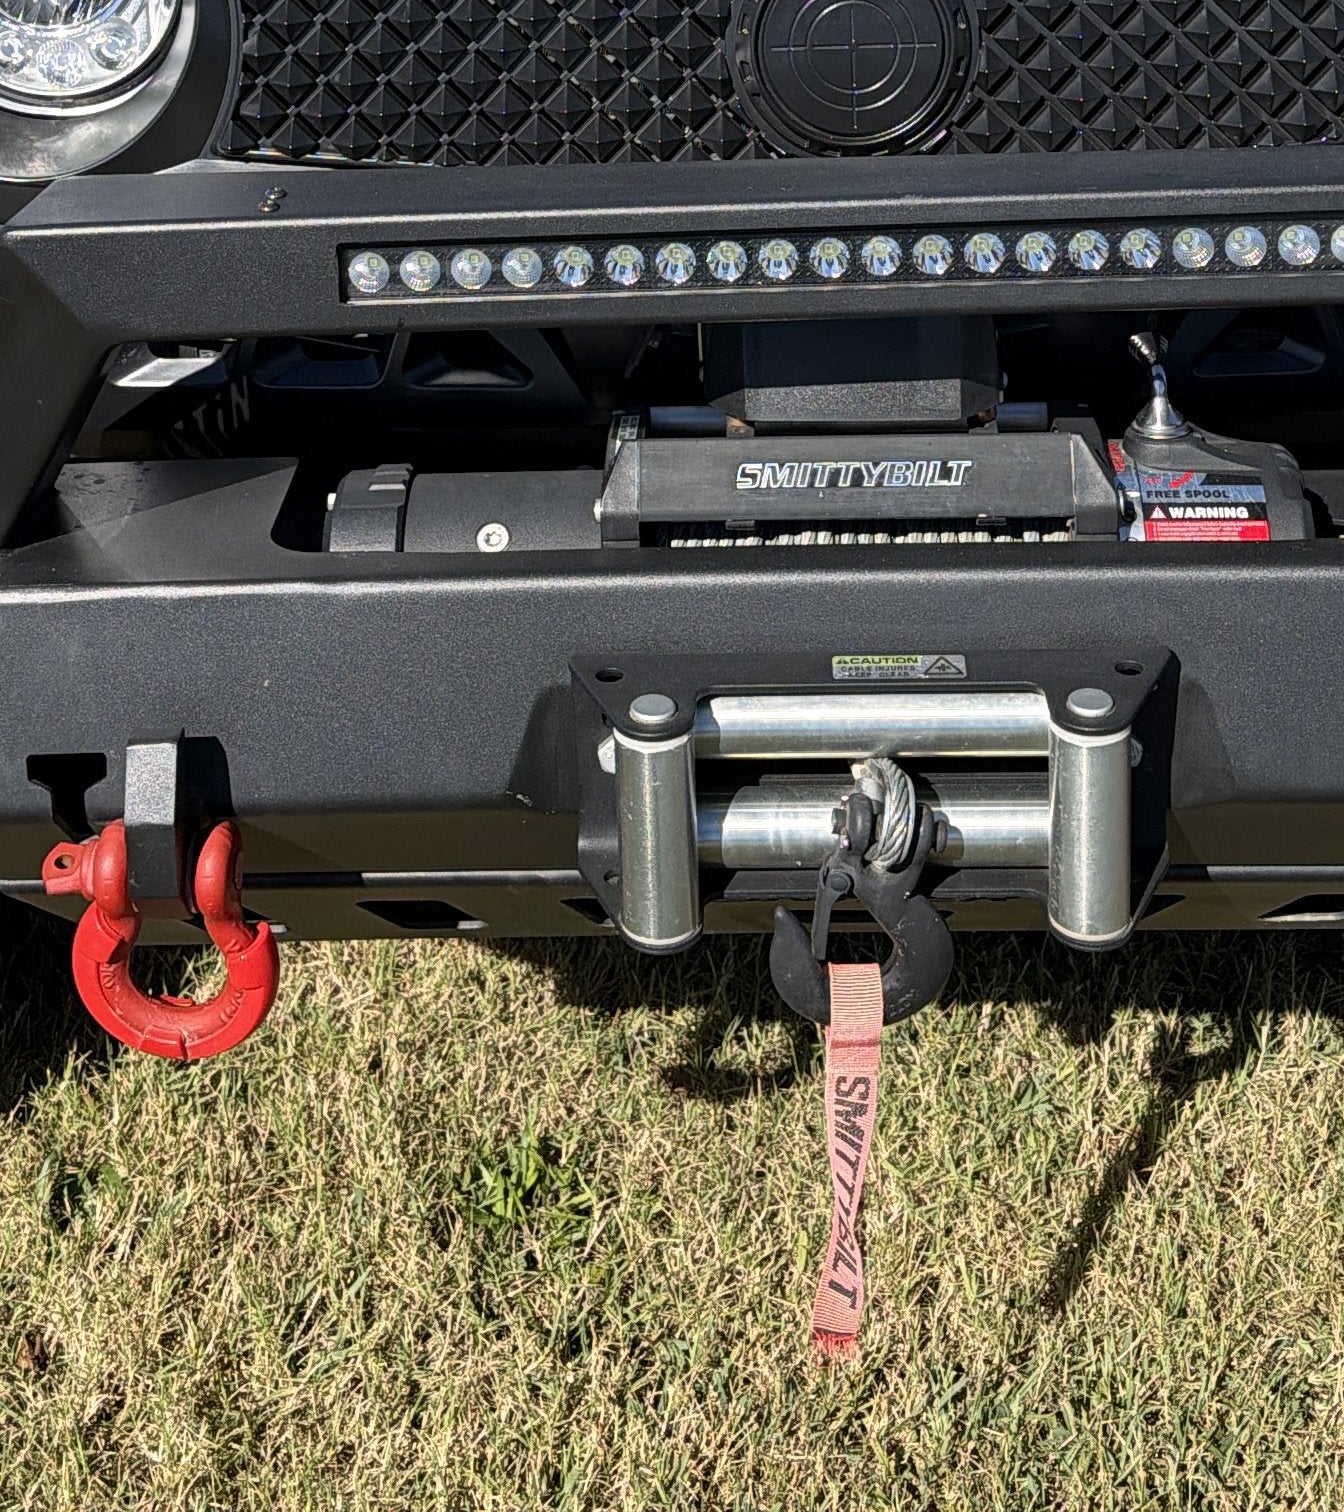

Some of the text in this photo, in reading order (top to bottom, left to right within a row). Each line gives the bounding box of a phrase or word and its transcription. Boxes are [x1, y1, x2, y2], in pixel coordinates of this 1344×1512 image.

[736, 460, 973, 489] SMITTYBILT
[1146, 489, 1231, 499] FREE SPOOL
[1168, 507, 1249, 519] WARNING
[850, 657, 919, 665] CAUTION
